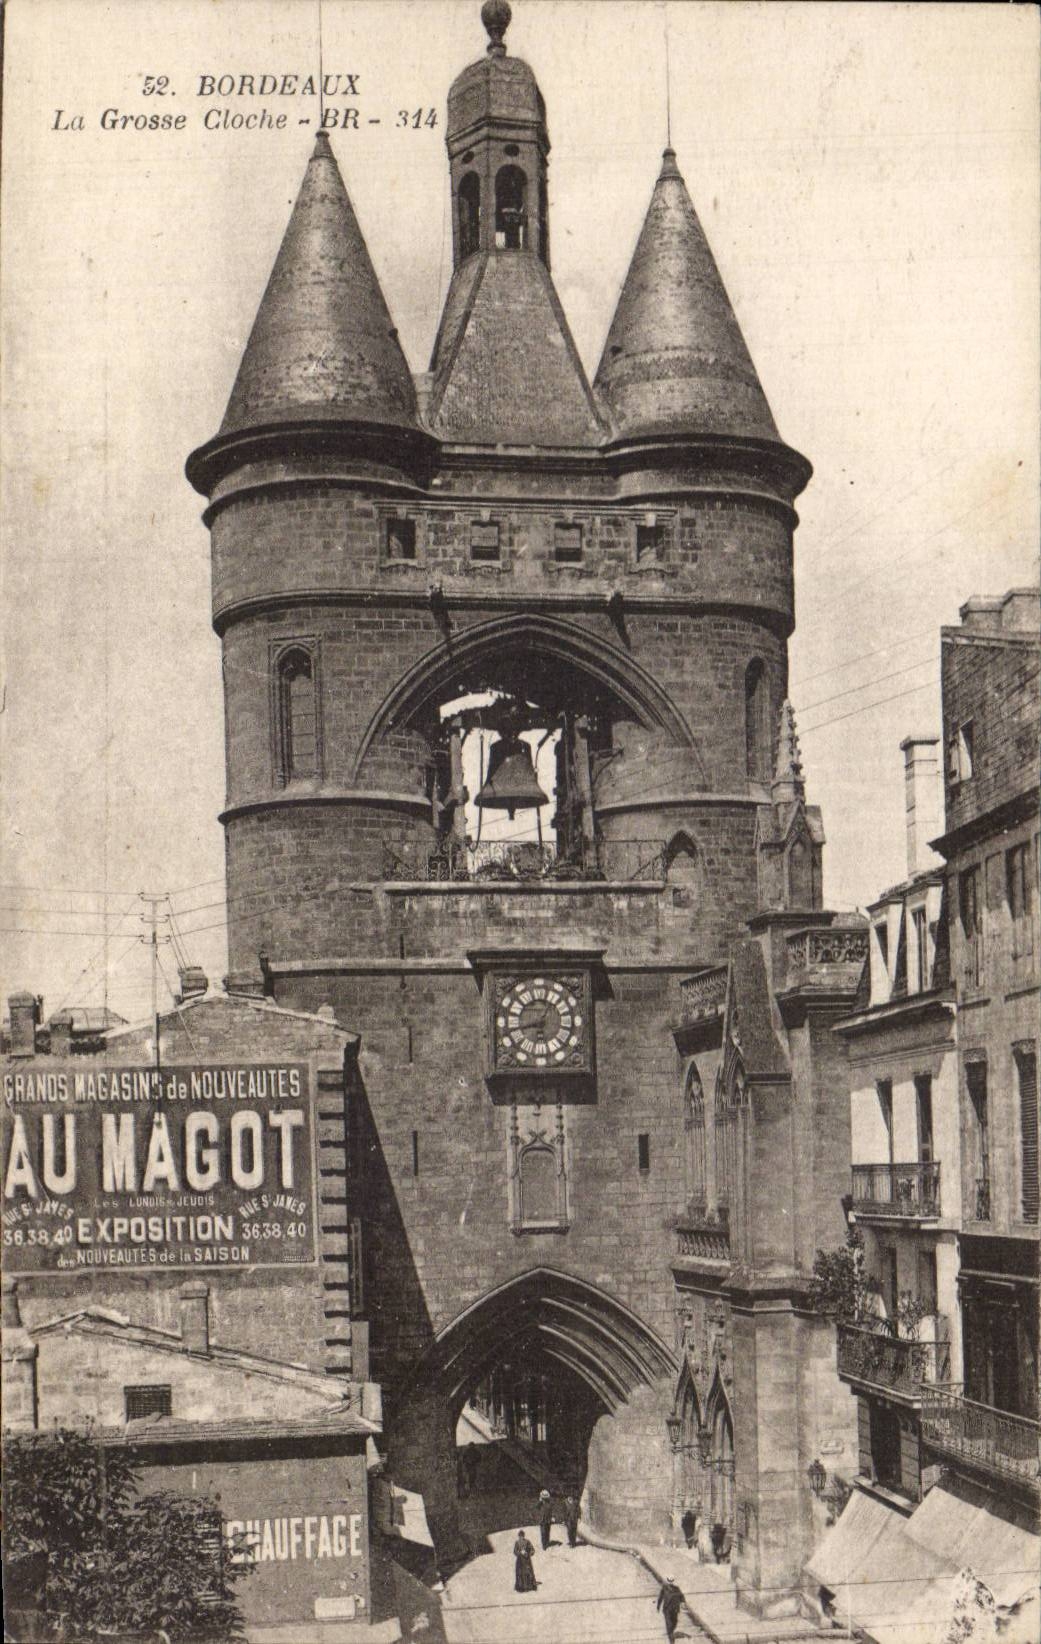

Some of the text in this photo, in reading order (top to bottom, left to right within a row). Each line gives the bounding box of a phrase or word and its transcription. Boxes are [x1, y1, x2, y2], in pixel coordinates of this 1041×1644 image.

[4, 1069, 300, 1102] GRANDS MAGASINS de NOUVEAUTES
[4, 1109, 305, 1199] AU MAGOT
[1, 1206, 22, 1226] RUE
[35, 1200, 75, 1220] JAMES
[129, 1196, 165, 1208] LUNDIS
[176, 1195, 215, 1208] JEUDIS
[238, 1197, 262, 1219] RUE
[273, 1194, 307, 1216] JAMES
[77, 1214, 235, 1244] EXPOSITION
[76, 1248, 156, 1264] NOUVEAUTES
[160, 1248, 176, 1262] de
[194, 1246, 249, 1262] SAISON
[226, 1513, 362, 1563] CHAUFFAGE
